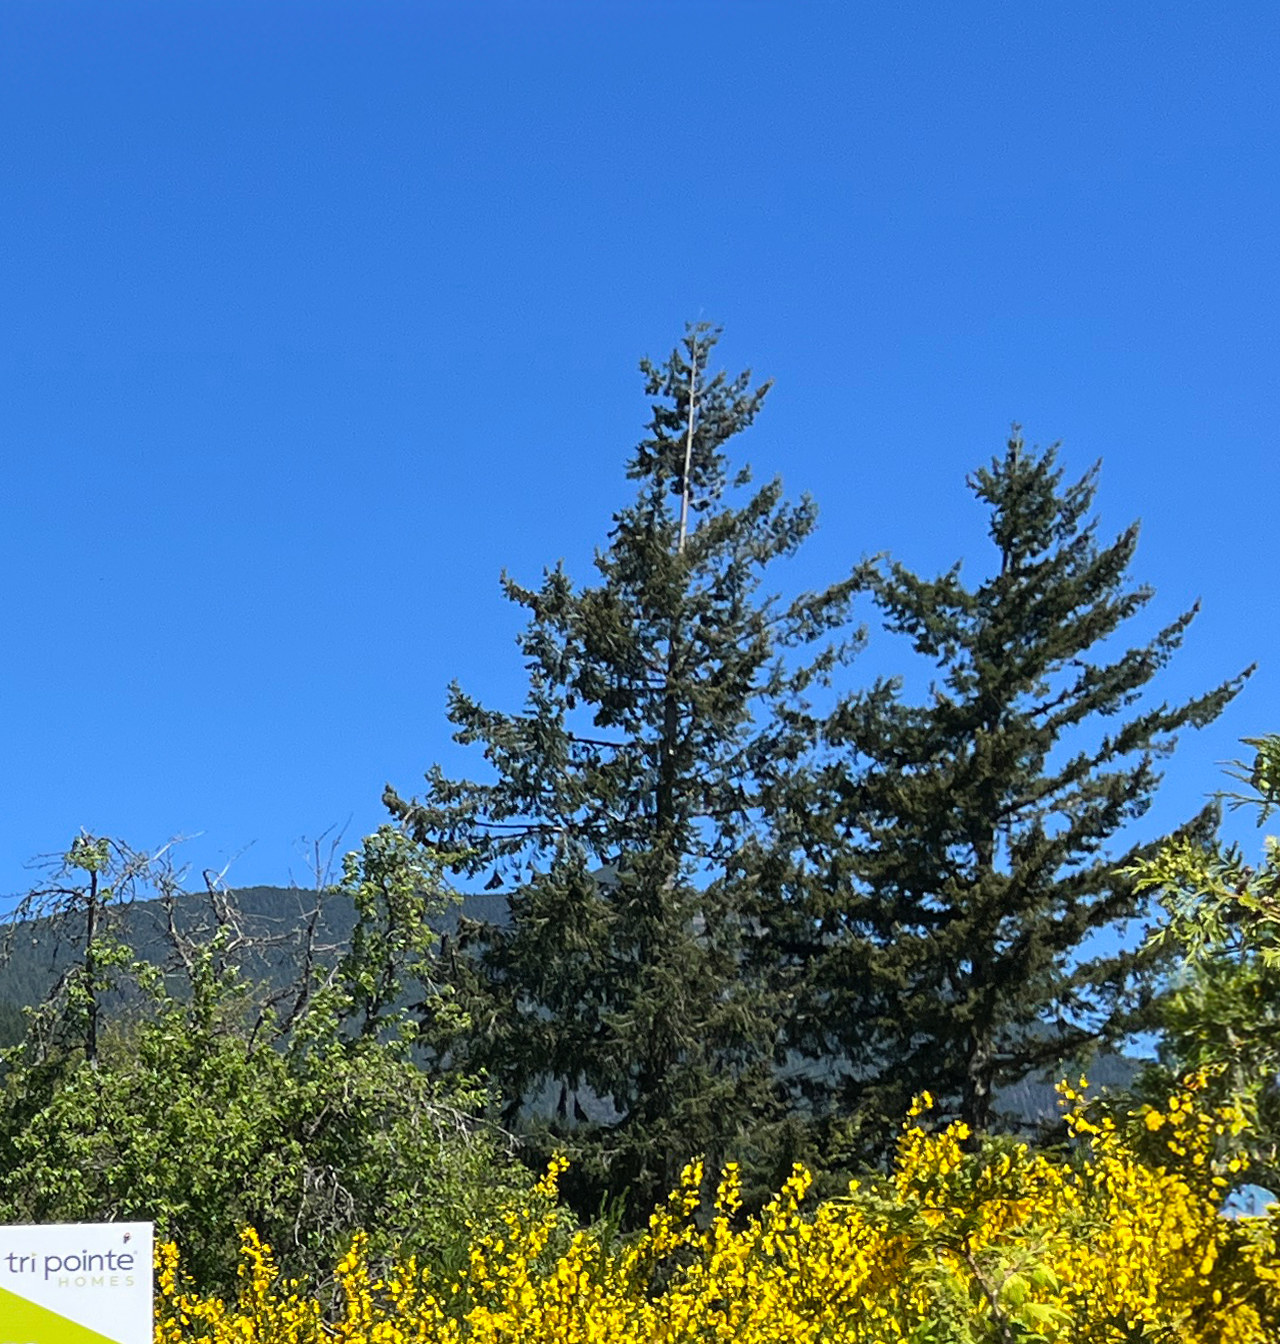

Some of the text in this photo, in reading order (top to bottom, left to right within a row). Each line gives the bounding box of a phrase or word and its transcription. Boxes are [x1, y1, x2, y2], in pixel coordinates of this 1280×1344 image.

[4, 1249, 135, 1280] tri pointe
[58, 1275, 135, 1288] HOMES
